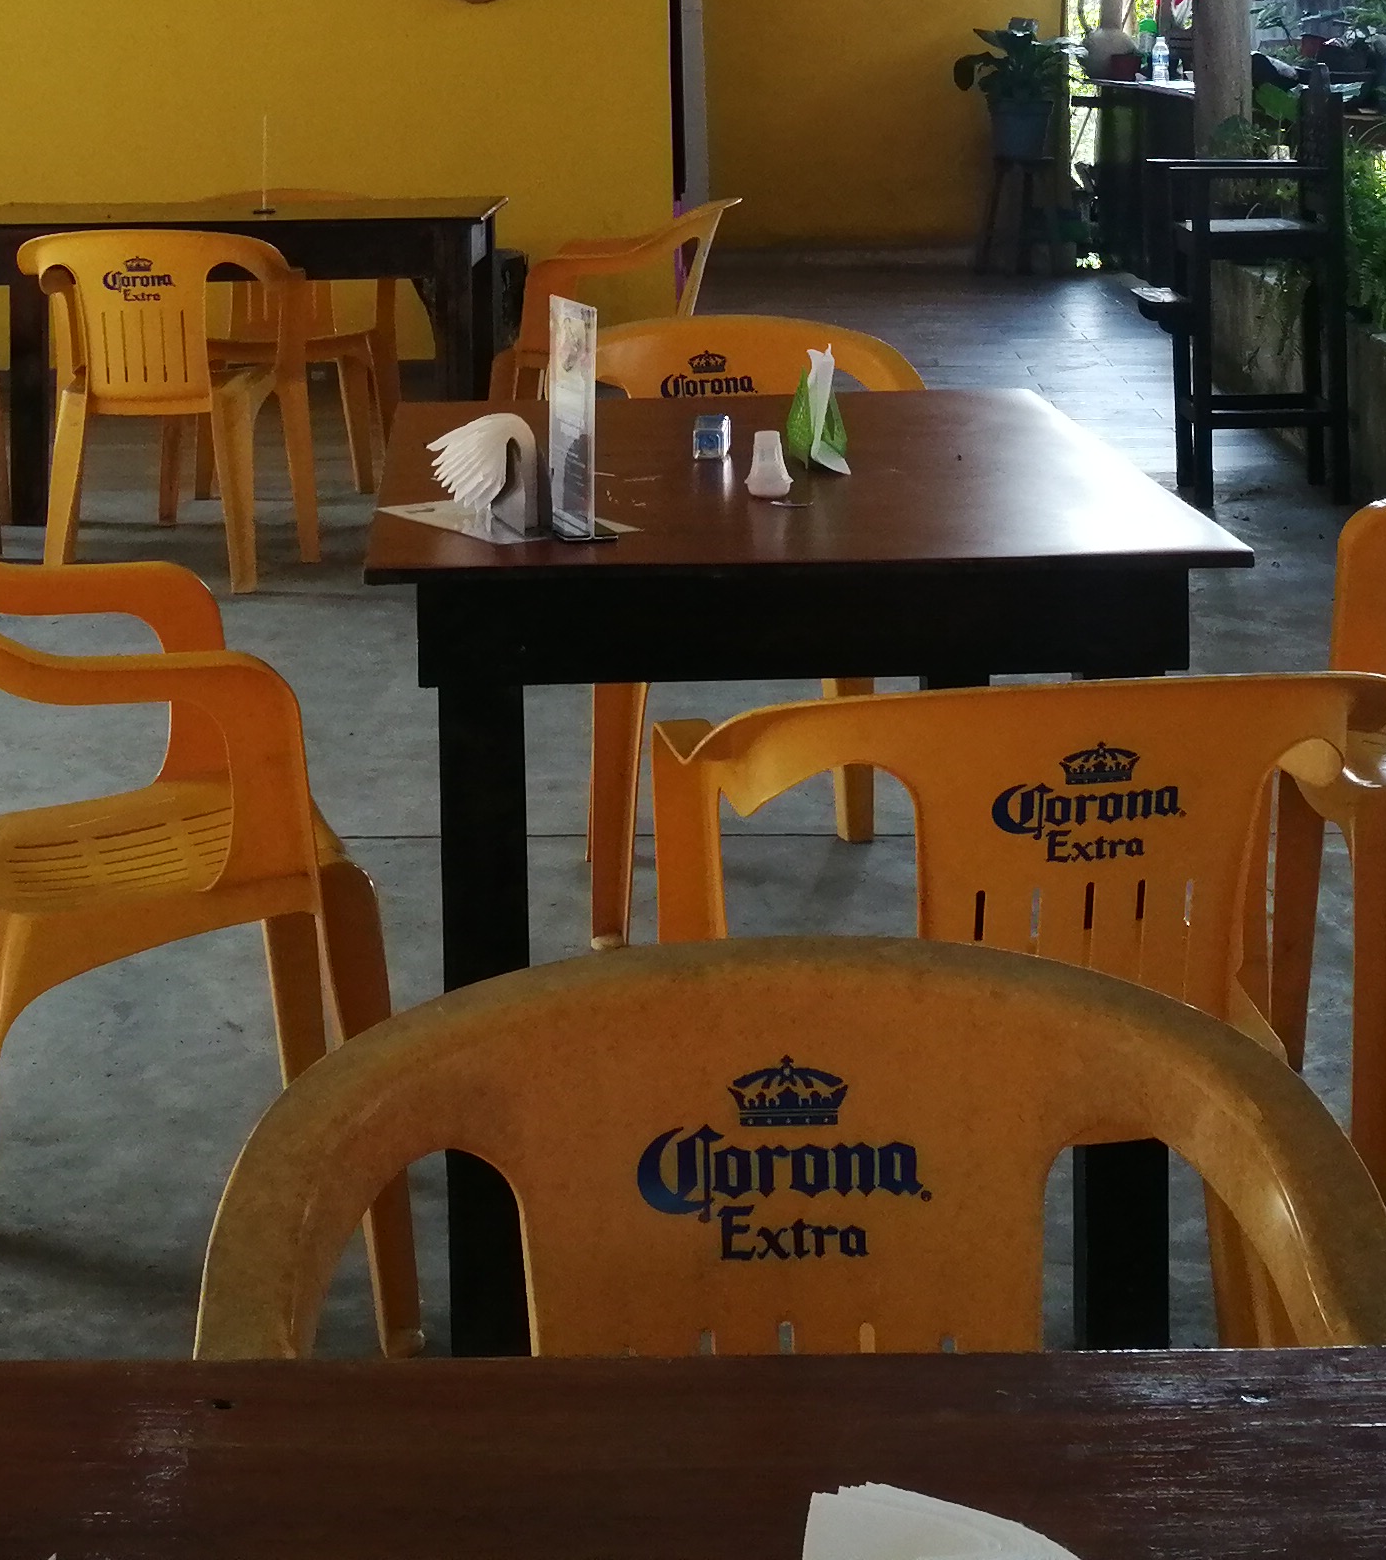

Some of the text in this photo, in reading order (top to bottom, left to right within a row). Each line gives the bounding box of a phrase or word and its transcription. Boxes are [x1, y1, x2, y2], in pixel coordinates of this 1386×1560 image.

[103, 271, 174, 292] Corona
[123, 289, 161, 302] Extra
[660, 373, 755, 398] Corona
[991, 782, 1182, 840] Corona
[1045, 829, 1145, 863] Extra
[636, 1124, 925, 1223] Corona
[717, 1204, 870, 1261] Extra
